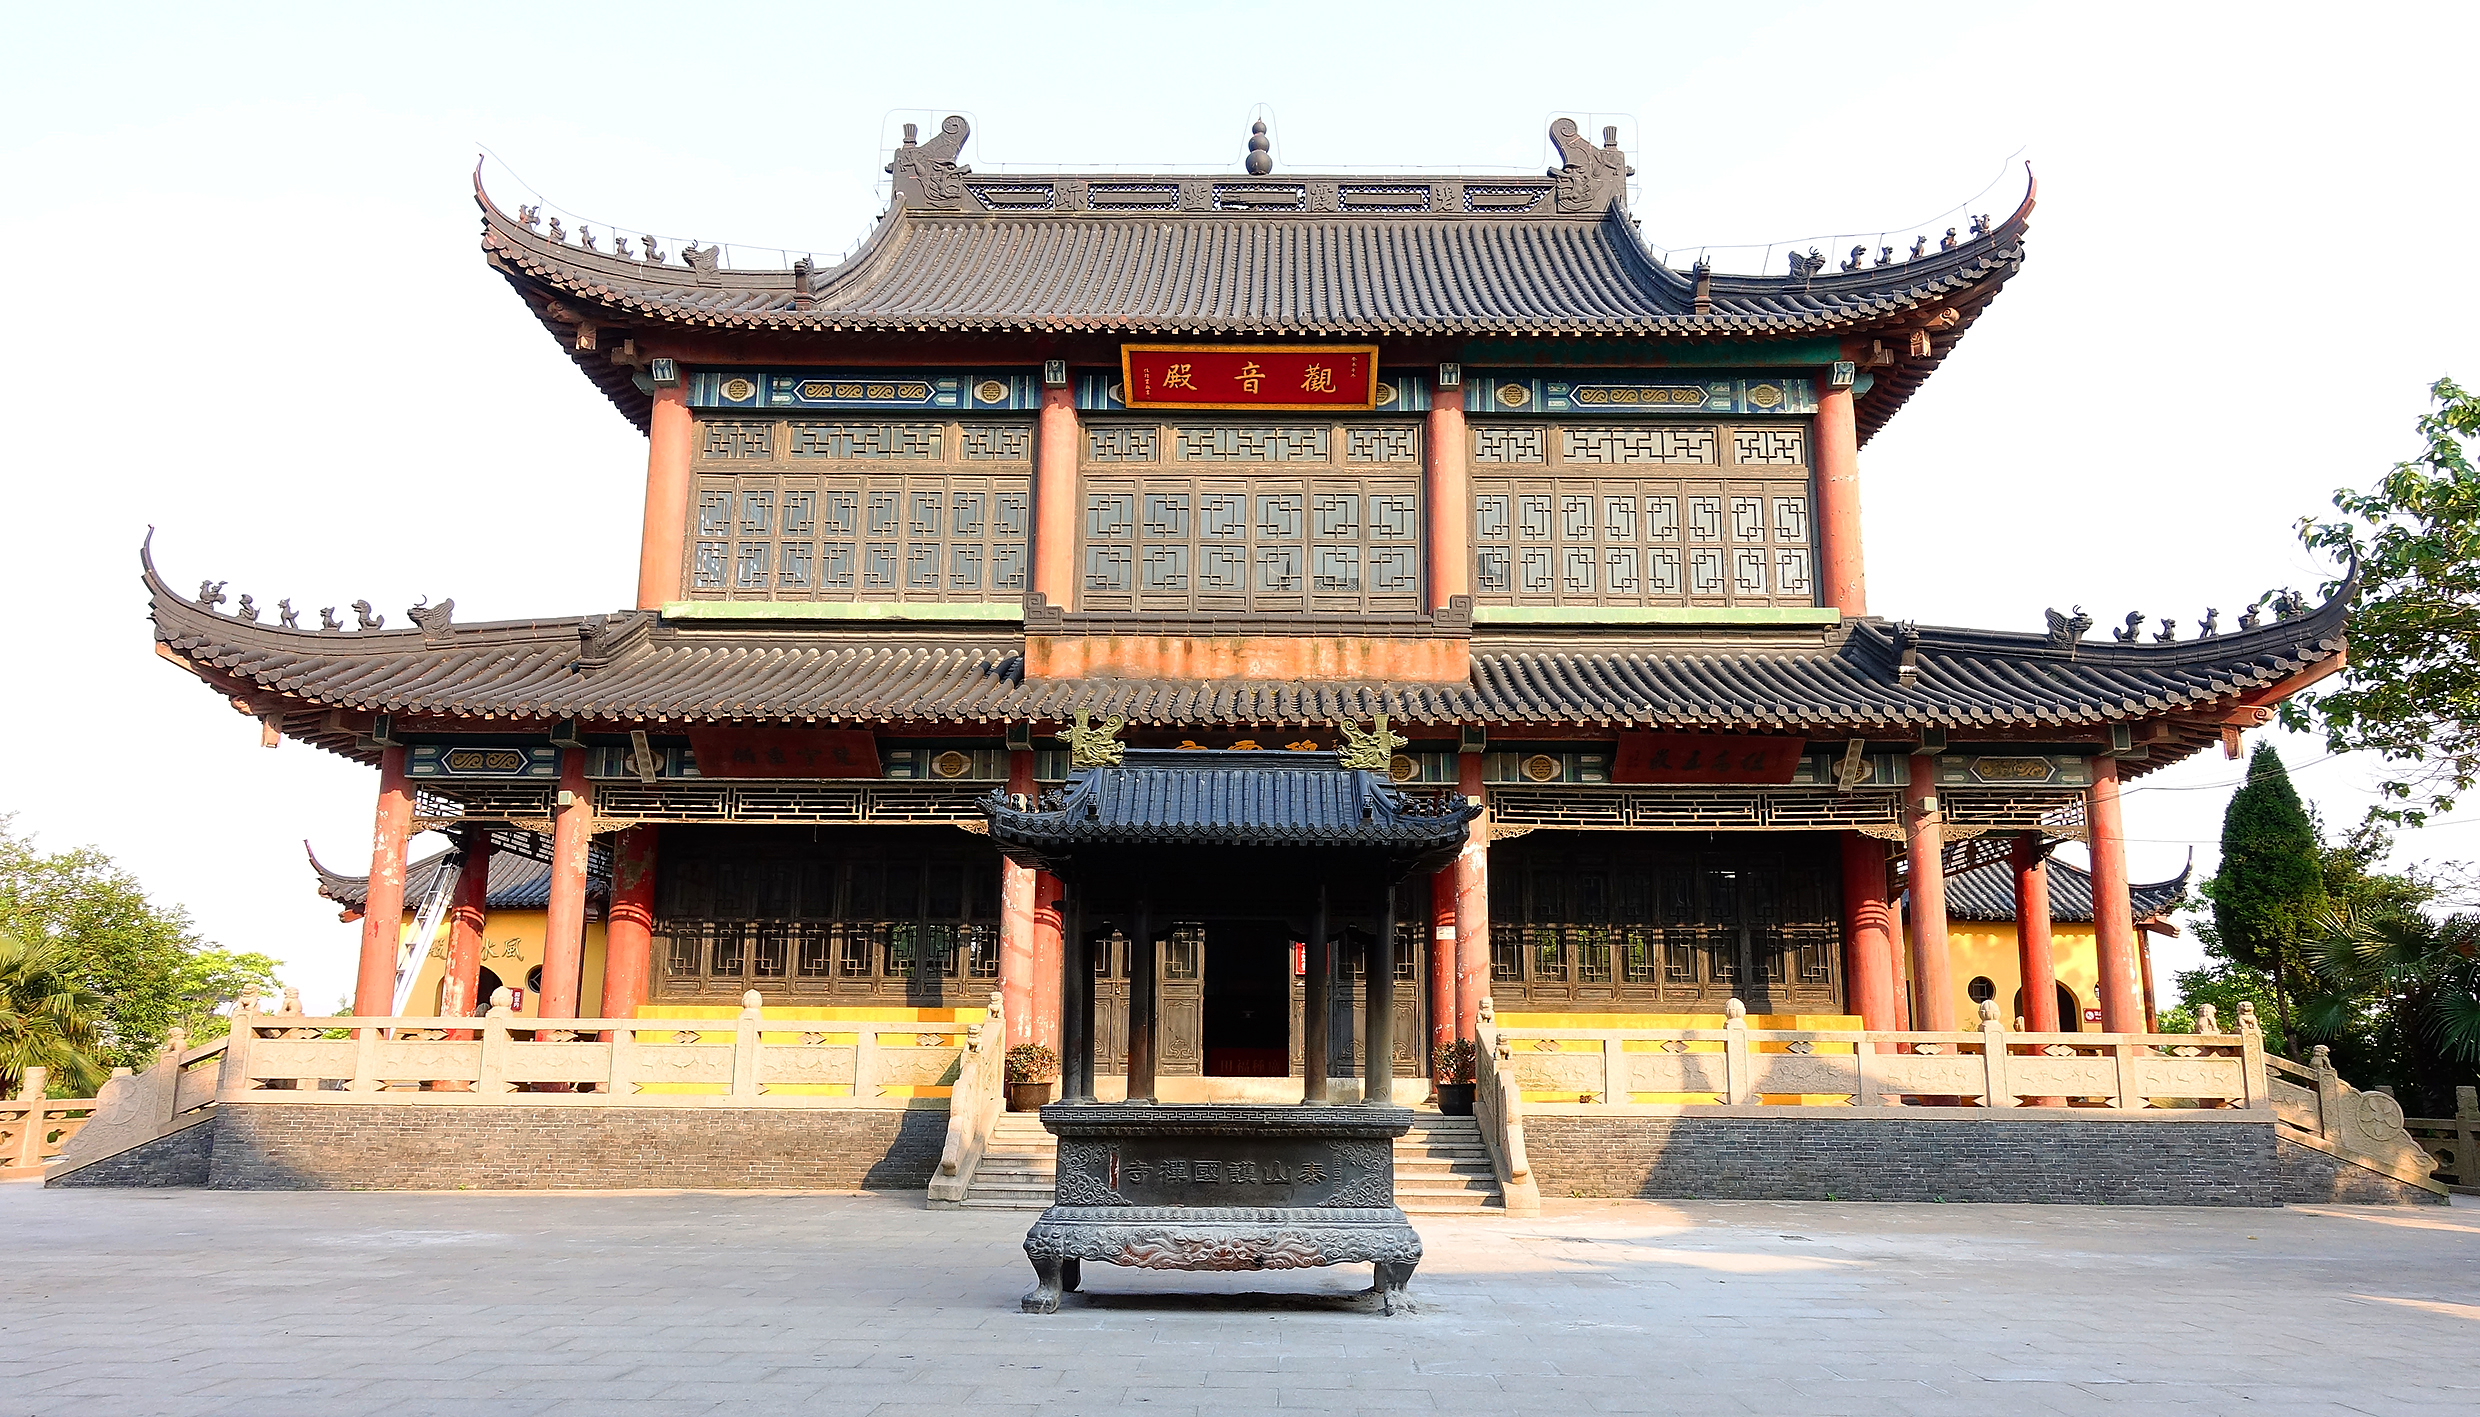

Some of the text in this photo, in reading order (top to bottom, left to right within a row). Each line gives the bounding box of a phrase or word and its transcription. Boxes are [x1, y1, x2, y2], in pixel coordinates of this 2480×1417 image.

[1162, 361, 1336, 394] 觀音殿
[1123, 1159, 1329, 1185] 泰山護國禪寺
